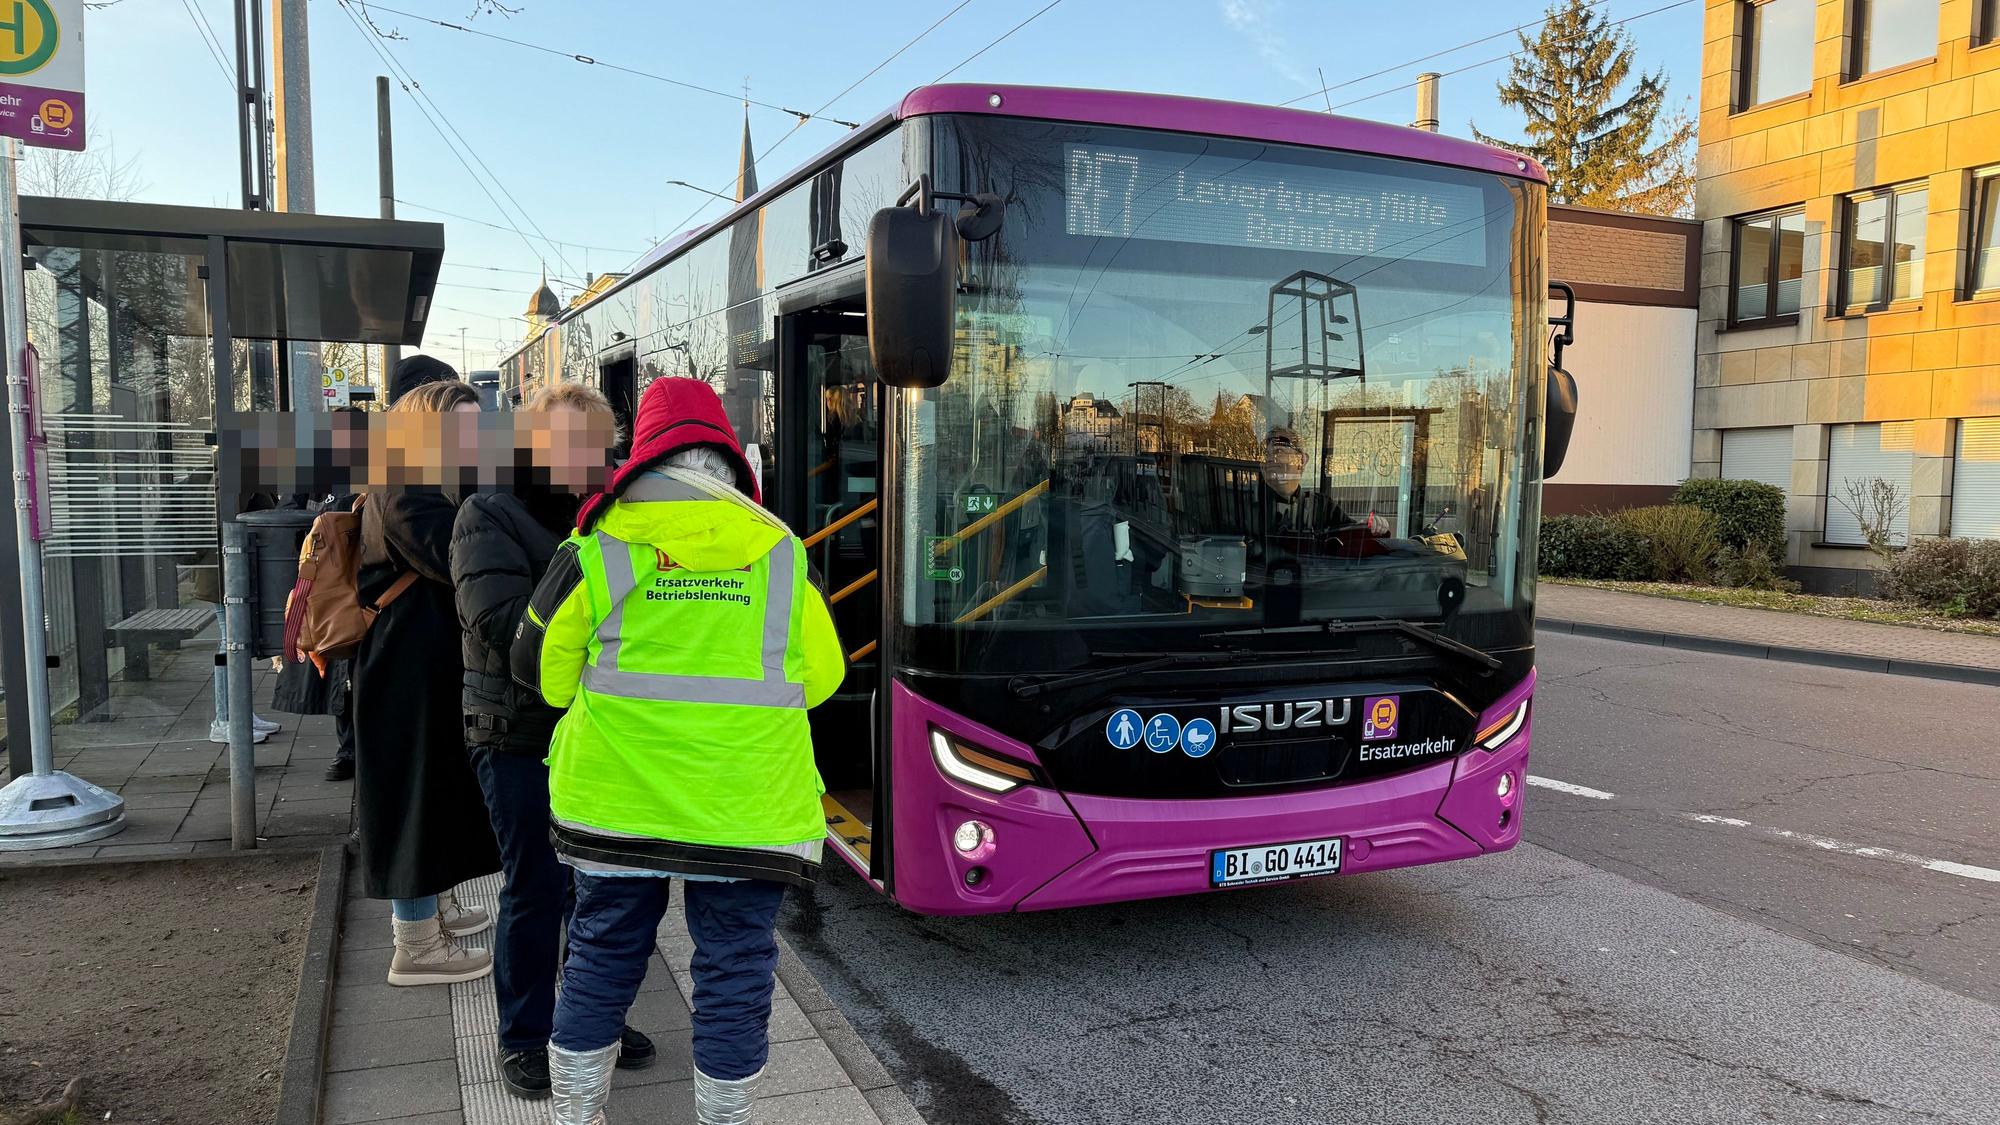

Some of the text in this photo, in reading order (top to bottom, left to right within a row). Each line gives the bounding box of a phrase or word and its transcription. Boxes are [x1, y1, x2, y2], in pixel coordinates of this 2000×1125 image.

[1070, 150, 1138, 238] RE7
[1177, 170, 1447, 226] Leverkusen Mitte
[1247, 213, 1379, 252] Bahnhof
[646, 590, 751, 606] Betriebslenkung
[655, 577, 744, 589] Ersatzverkehr
[1220, 699, 1351, 734] ISUZU
[1359, 735, 1456, 761] Ersatzverkehr
[1226, 843, 1337, 877] BI GO 4414
